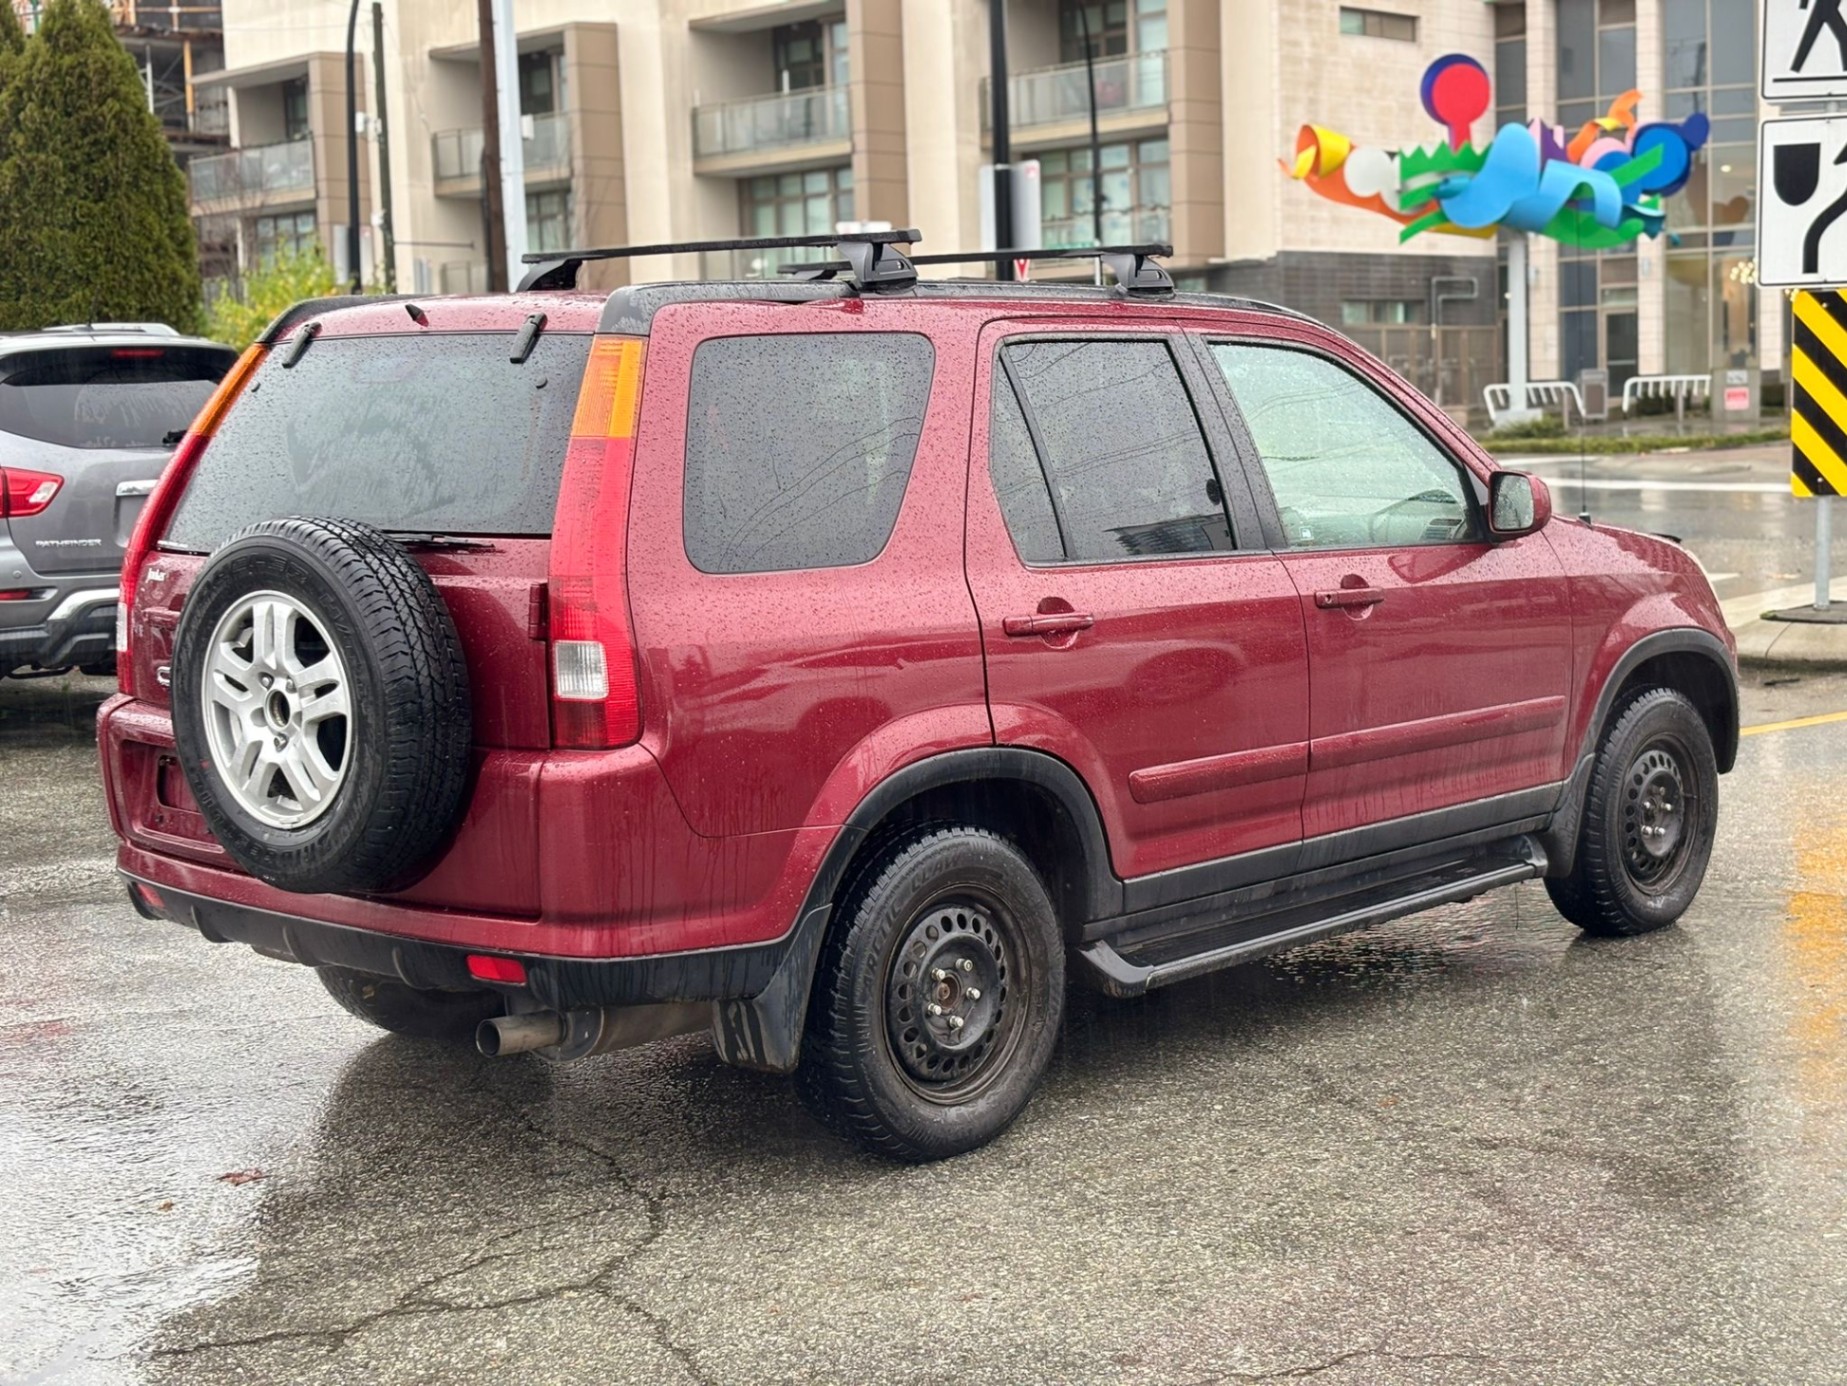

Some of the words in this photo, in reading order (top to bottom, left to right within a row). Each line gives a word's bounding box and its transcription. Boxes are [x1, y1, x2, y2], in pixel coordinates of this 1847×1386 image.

[35, 538, 102, 548] PATHFINDER
[860, 898, 902, 989] ARCTIC
[909, 852, 963, 894] CLAW
